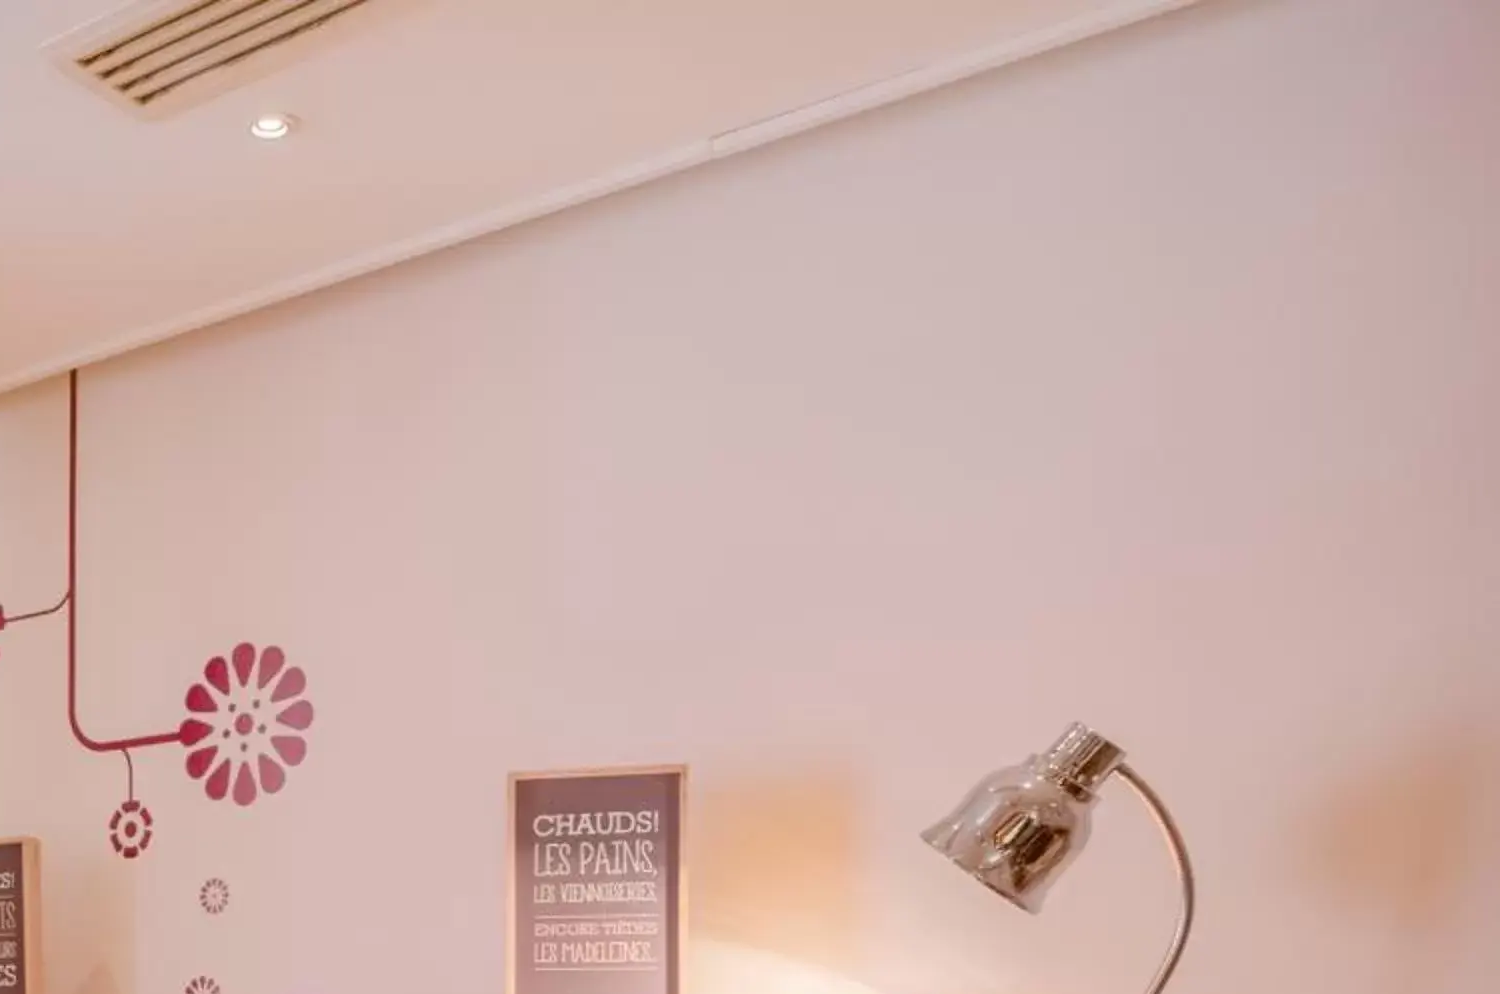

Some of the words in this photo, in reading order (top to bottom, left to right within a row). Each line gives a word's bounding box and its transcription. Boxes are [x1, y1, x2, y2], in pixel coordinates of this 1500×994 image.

[533, 810, 659, 836] CHAUDS!
[534, 843, 571, 877] LES
[579, 840, 658, 877] PAINS,
